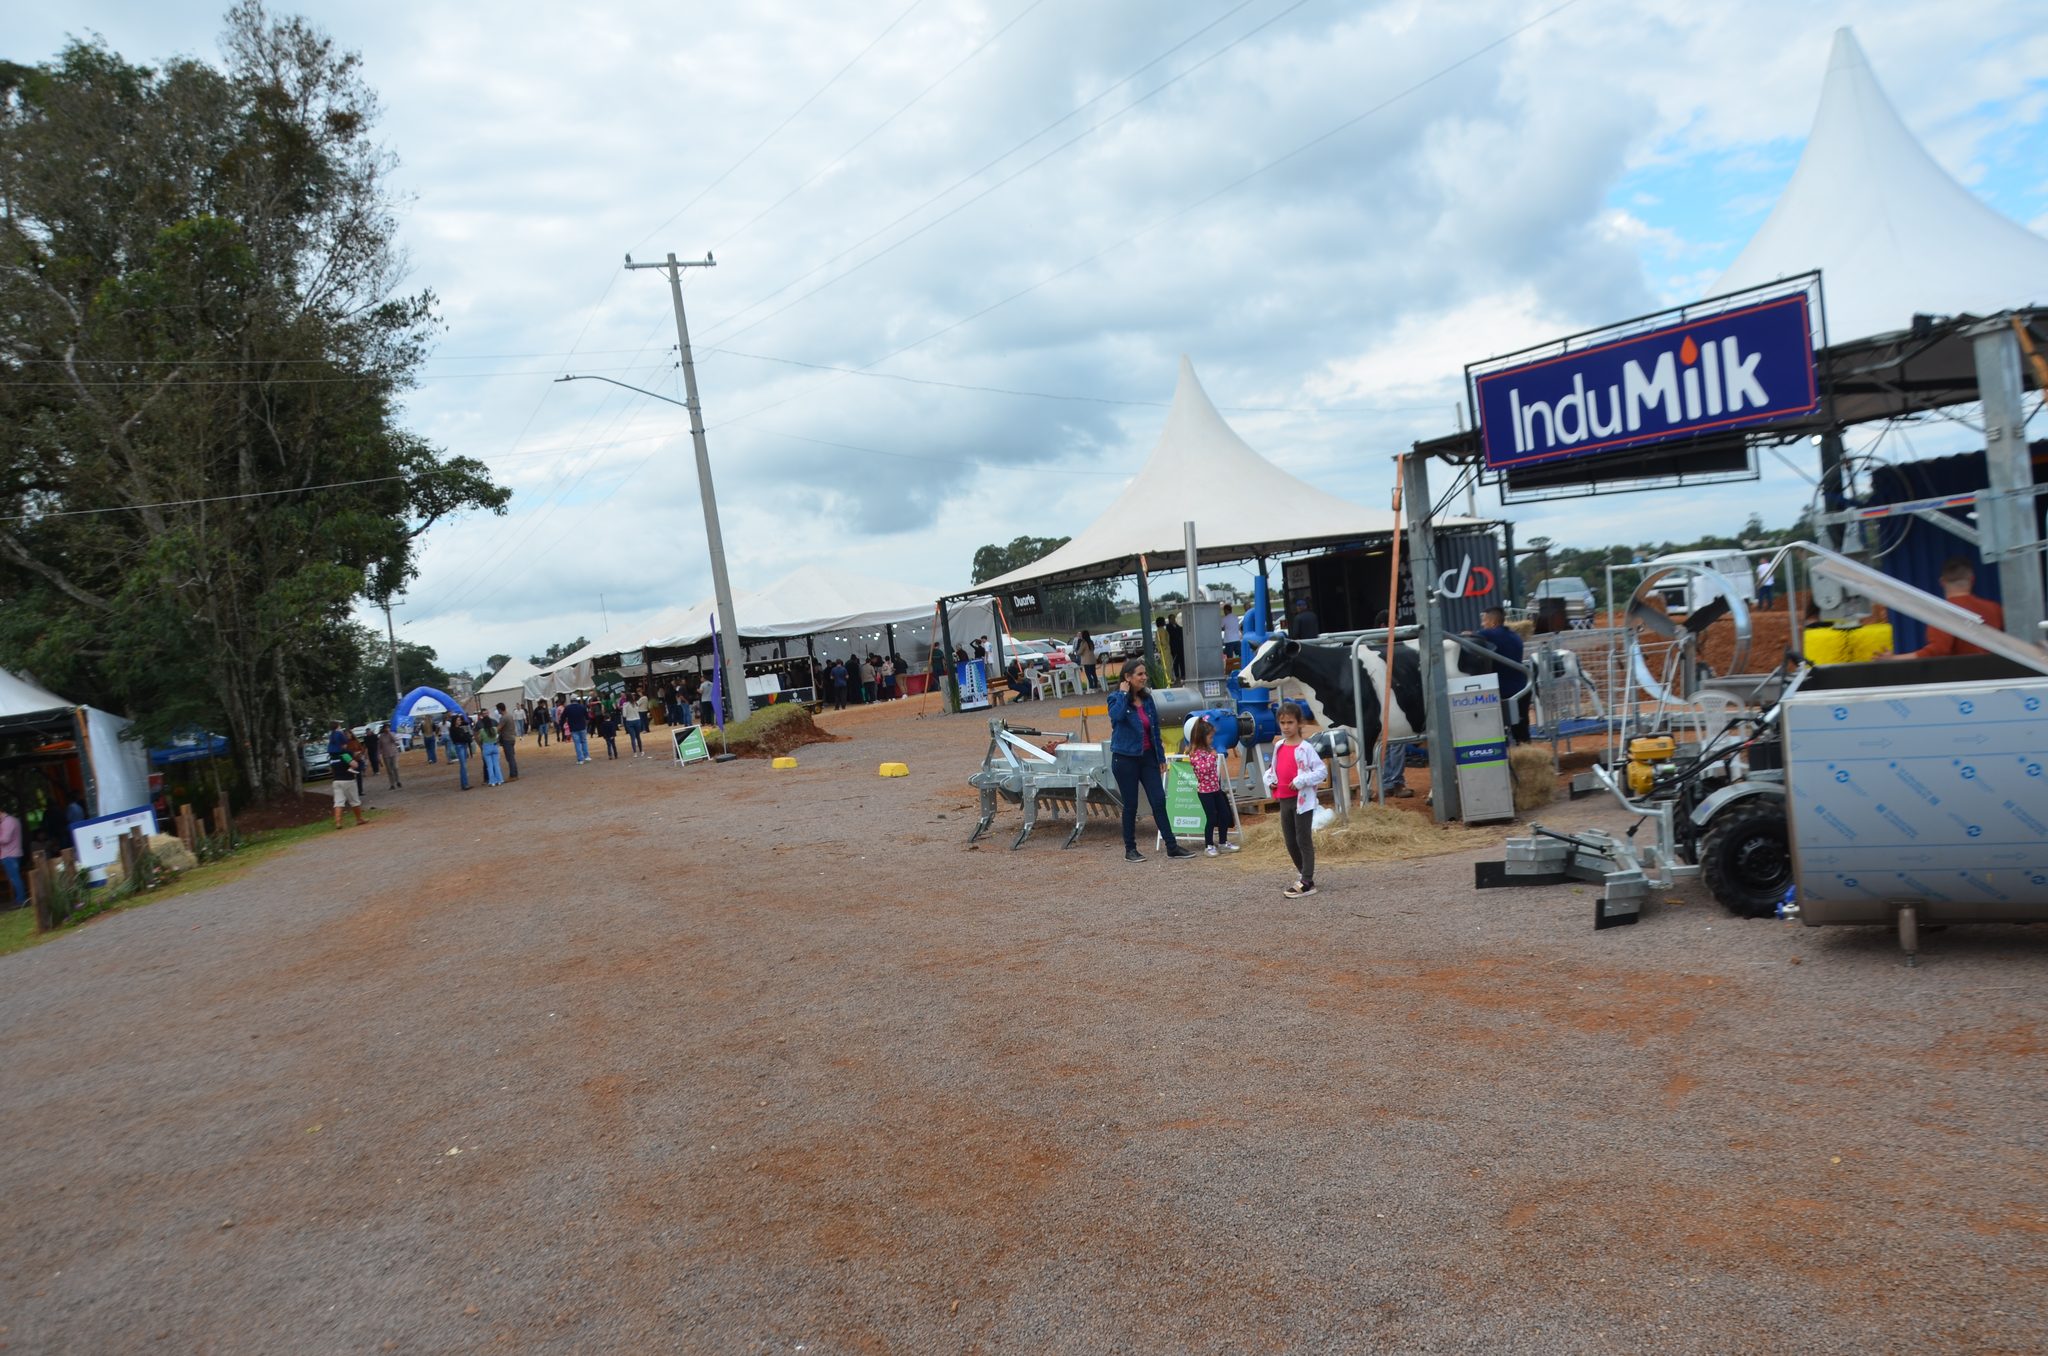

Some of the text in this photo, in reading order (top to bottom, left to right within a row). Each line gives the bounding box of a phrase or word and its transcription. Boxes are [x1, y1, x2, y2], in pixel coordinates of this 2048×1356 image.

[1510, 334, 1769, 453] InduMilk
[1014, 594, 1036, 608] Duarte
[1452, 692, 1499, 707] InduMilk
